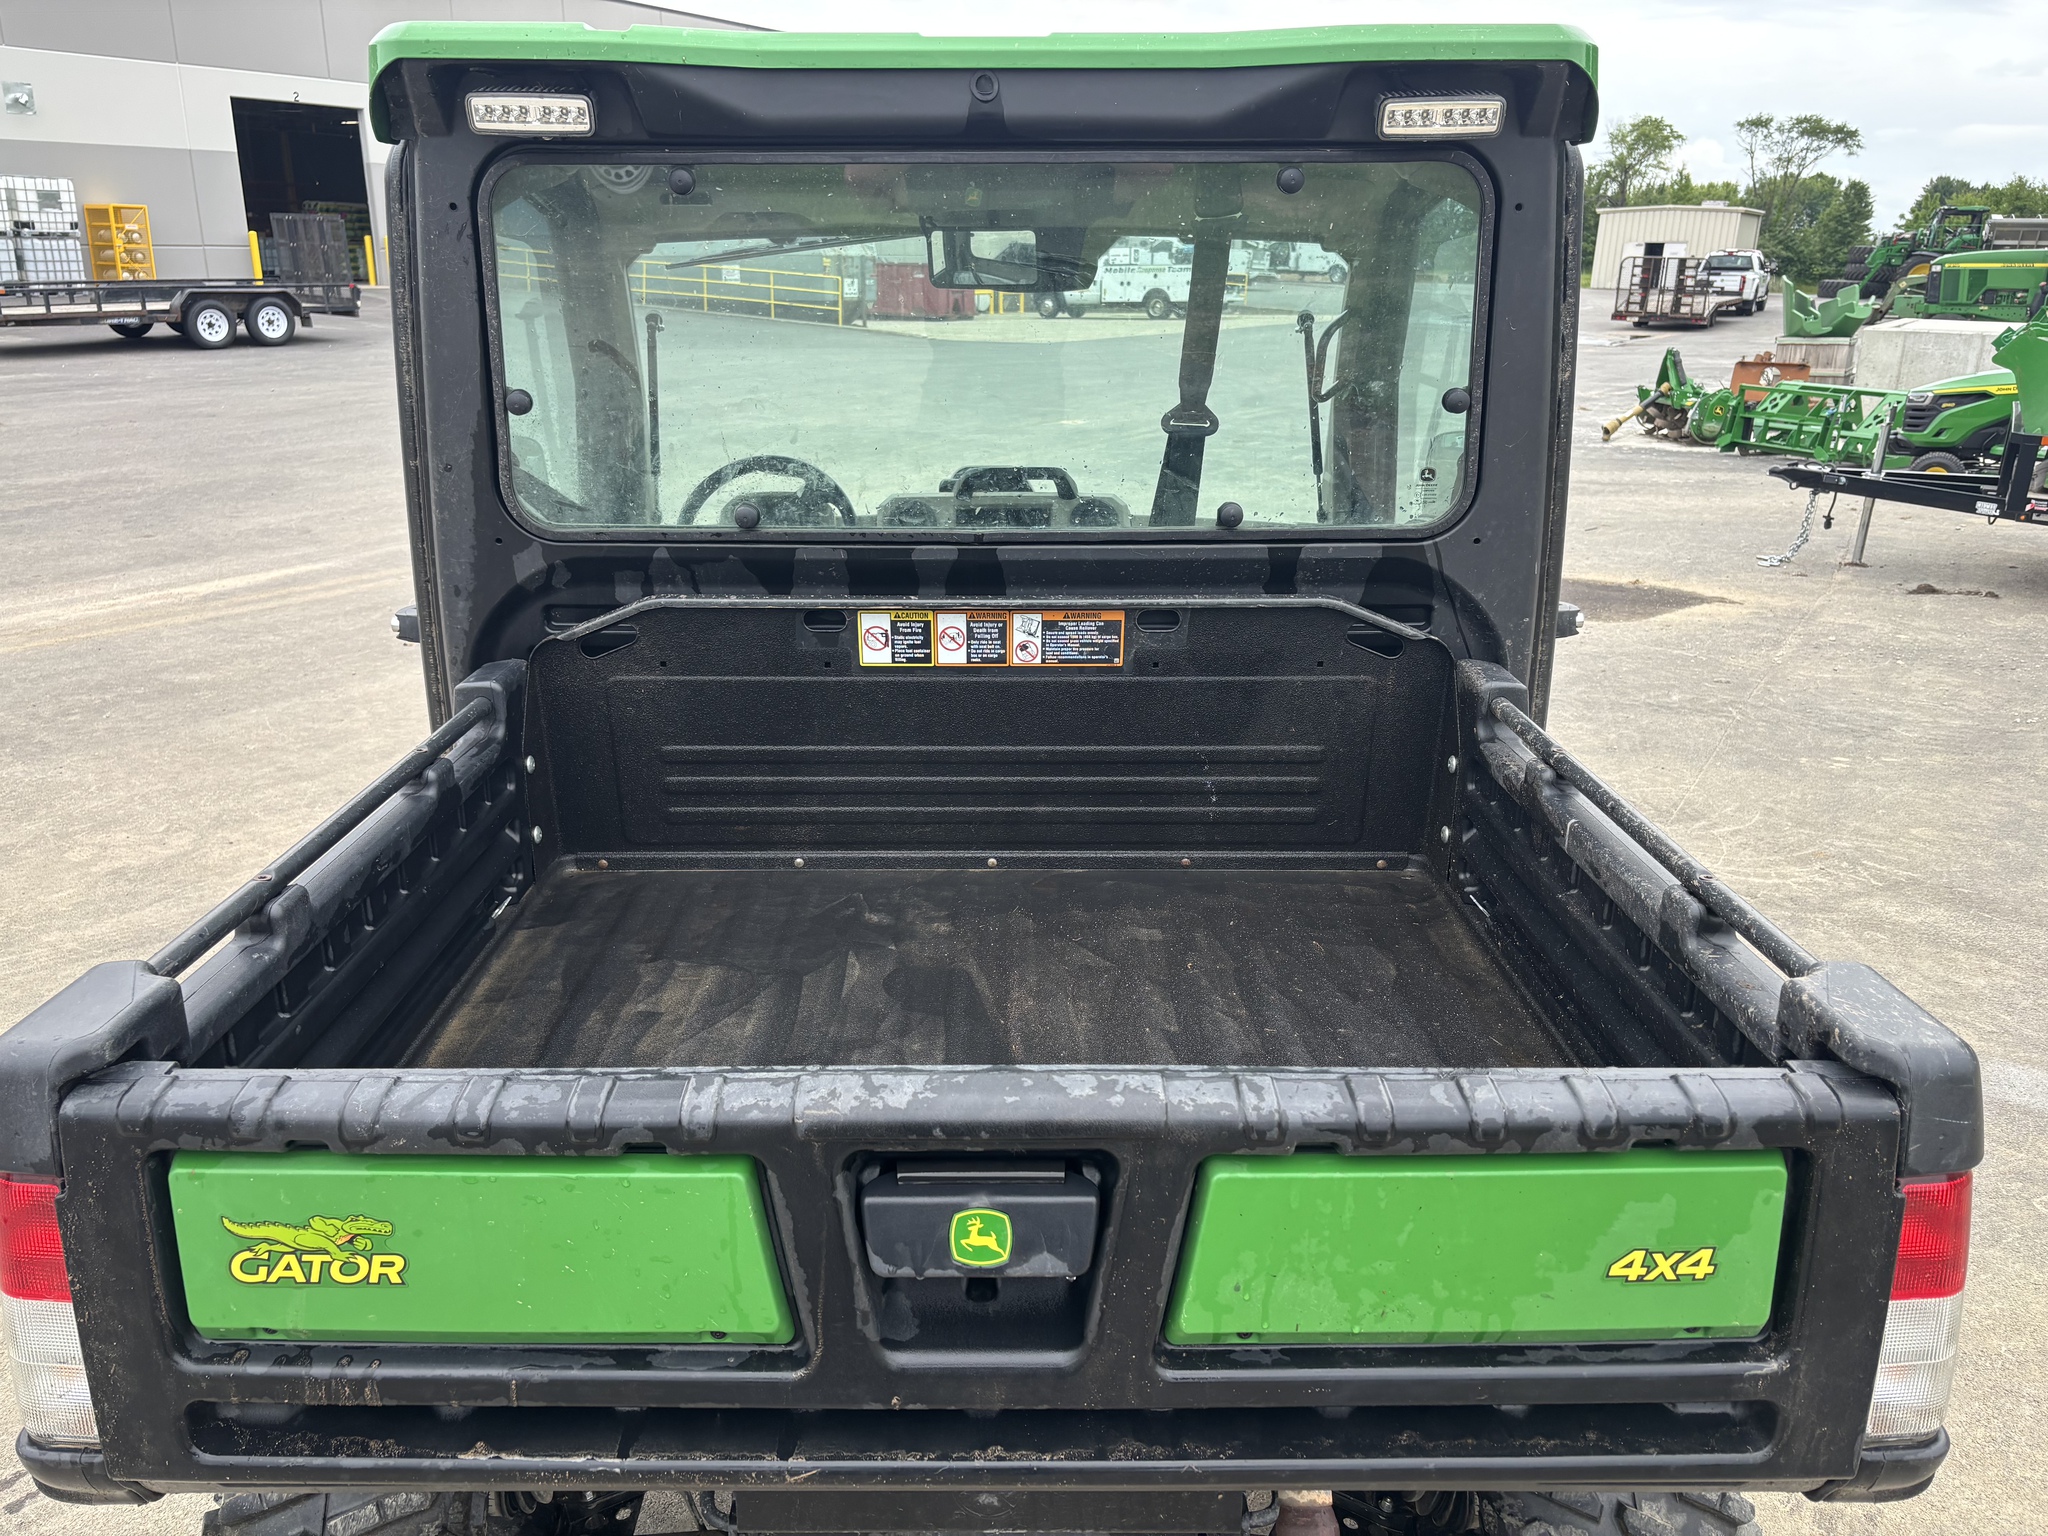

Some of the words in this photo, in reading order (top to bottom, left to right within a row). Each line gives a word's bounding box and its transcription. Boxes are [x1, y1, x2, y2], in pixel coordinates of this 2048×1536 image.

[293, 91, 299, 102] 2
[230, 1250, 406, 1284] GATOR
[1606, 1247, 1717, 1282] 4x4
